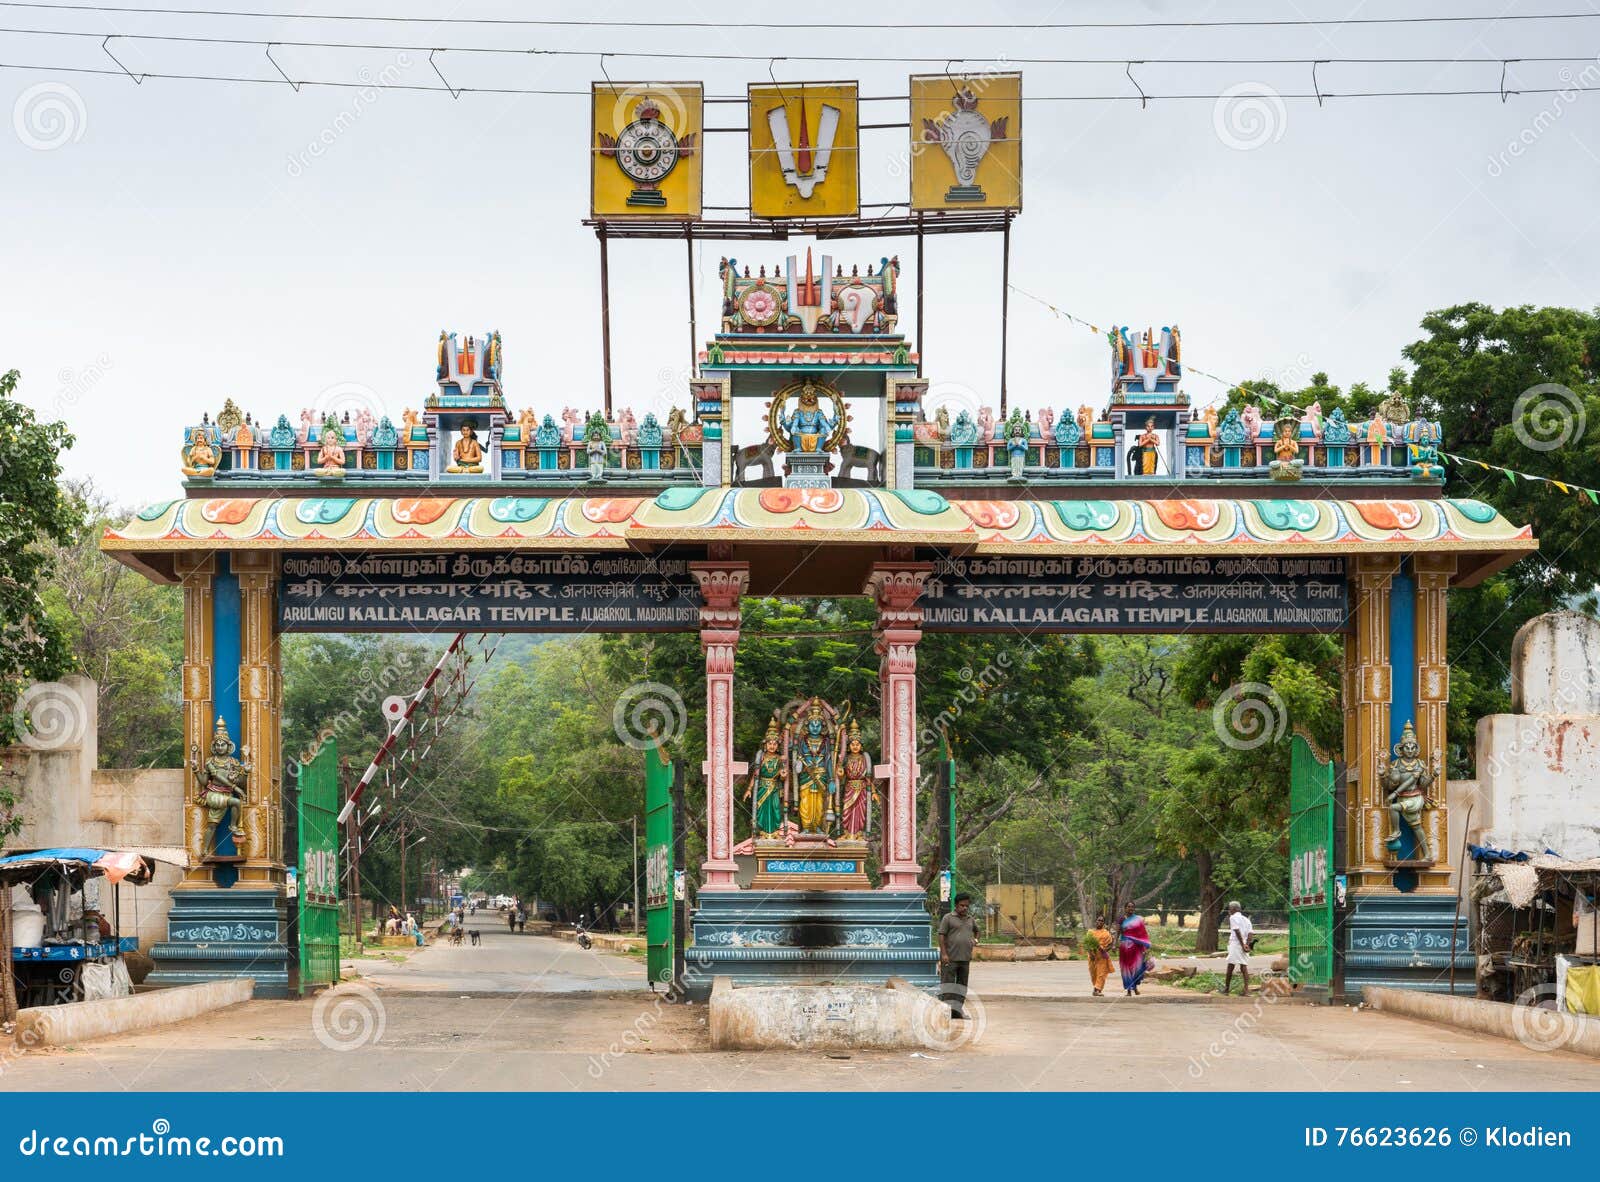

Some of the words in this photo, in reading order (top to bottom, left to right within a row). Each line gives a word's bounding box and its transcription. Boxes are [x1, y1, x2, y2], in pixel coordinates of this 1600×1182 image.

[284, 607, 344, 621] ARULMIGU
[349, 607, 480, 621] KALLALAGAR
[637, 607, 675, 621] MADURAI
[923, 608, 968, 622] ULMIGU
[973, 608, 1119, 622] KALLALAGAR
[1274, 608, 1310, 622] MADURAI
